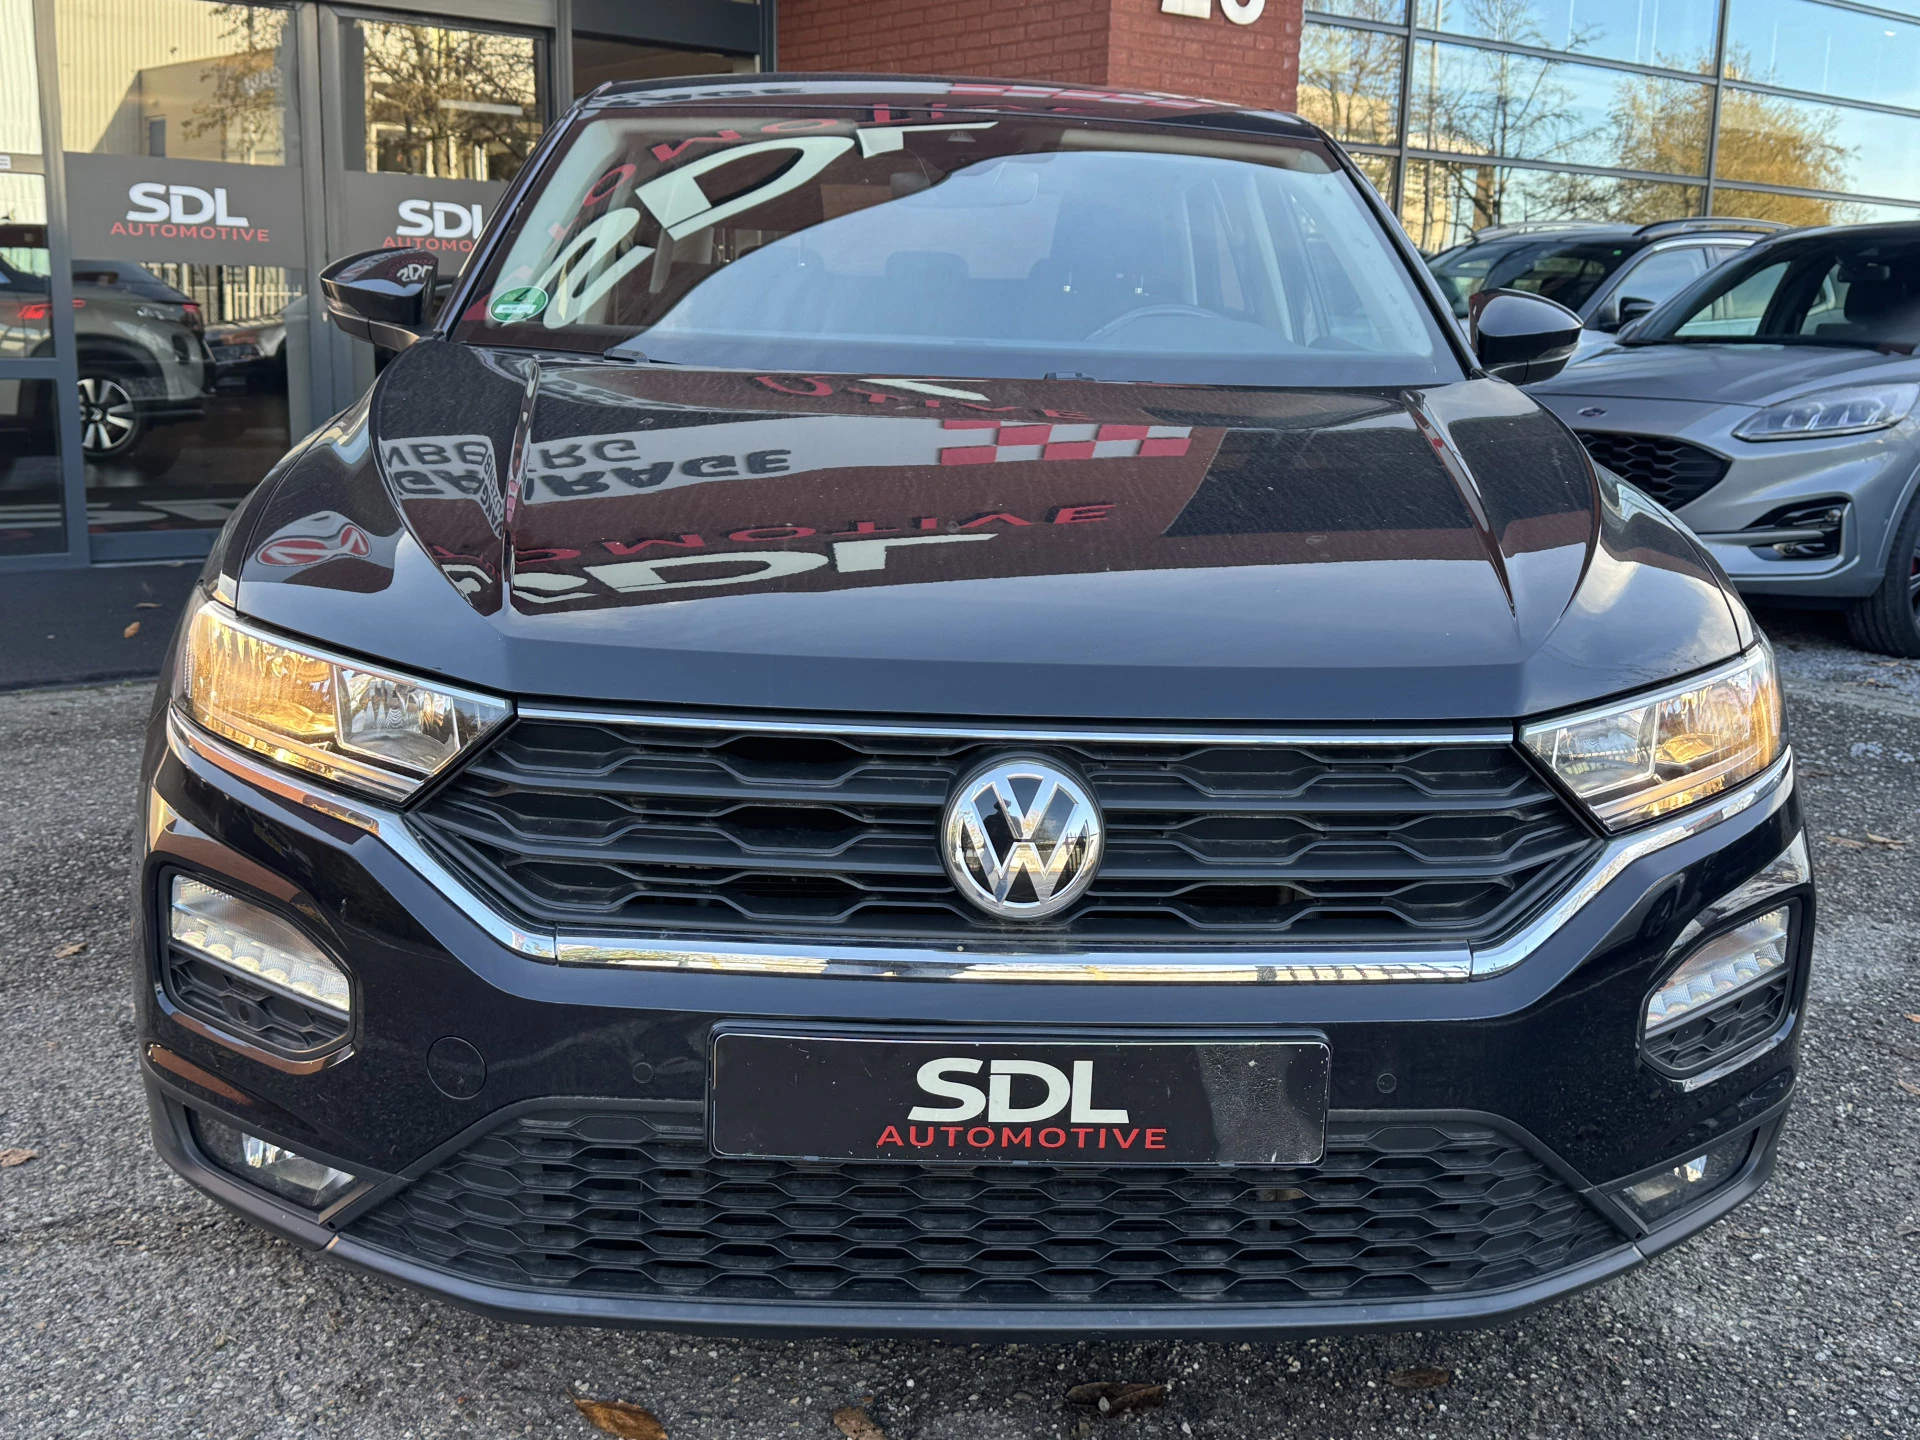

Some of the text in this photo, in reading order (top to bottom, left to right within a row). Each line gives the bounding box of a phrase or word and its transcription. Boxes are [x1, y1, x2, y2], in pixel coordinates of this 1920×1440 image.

[125, 181, 250, 228] SDL
[110, 221, 270, 242] AUTOMOTIVE
[382, 235, 475, 253] AUTOMO
[953, 768, 1095, 911] VW
[906, 1056, 1130, 1124] SDL
[876, 1125, 1167, 1149] AUTOMOTIVE
